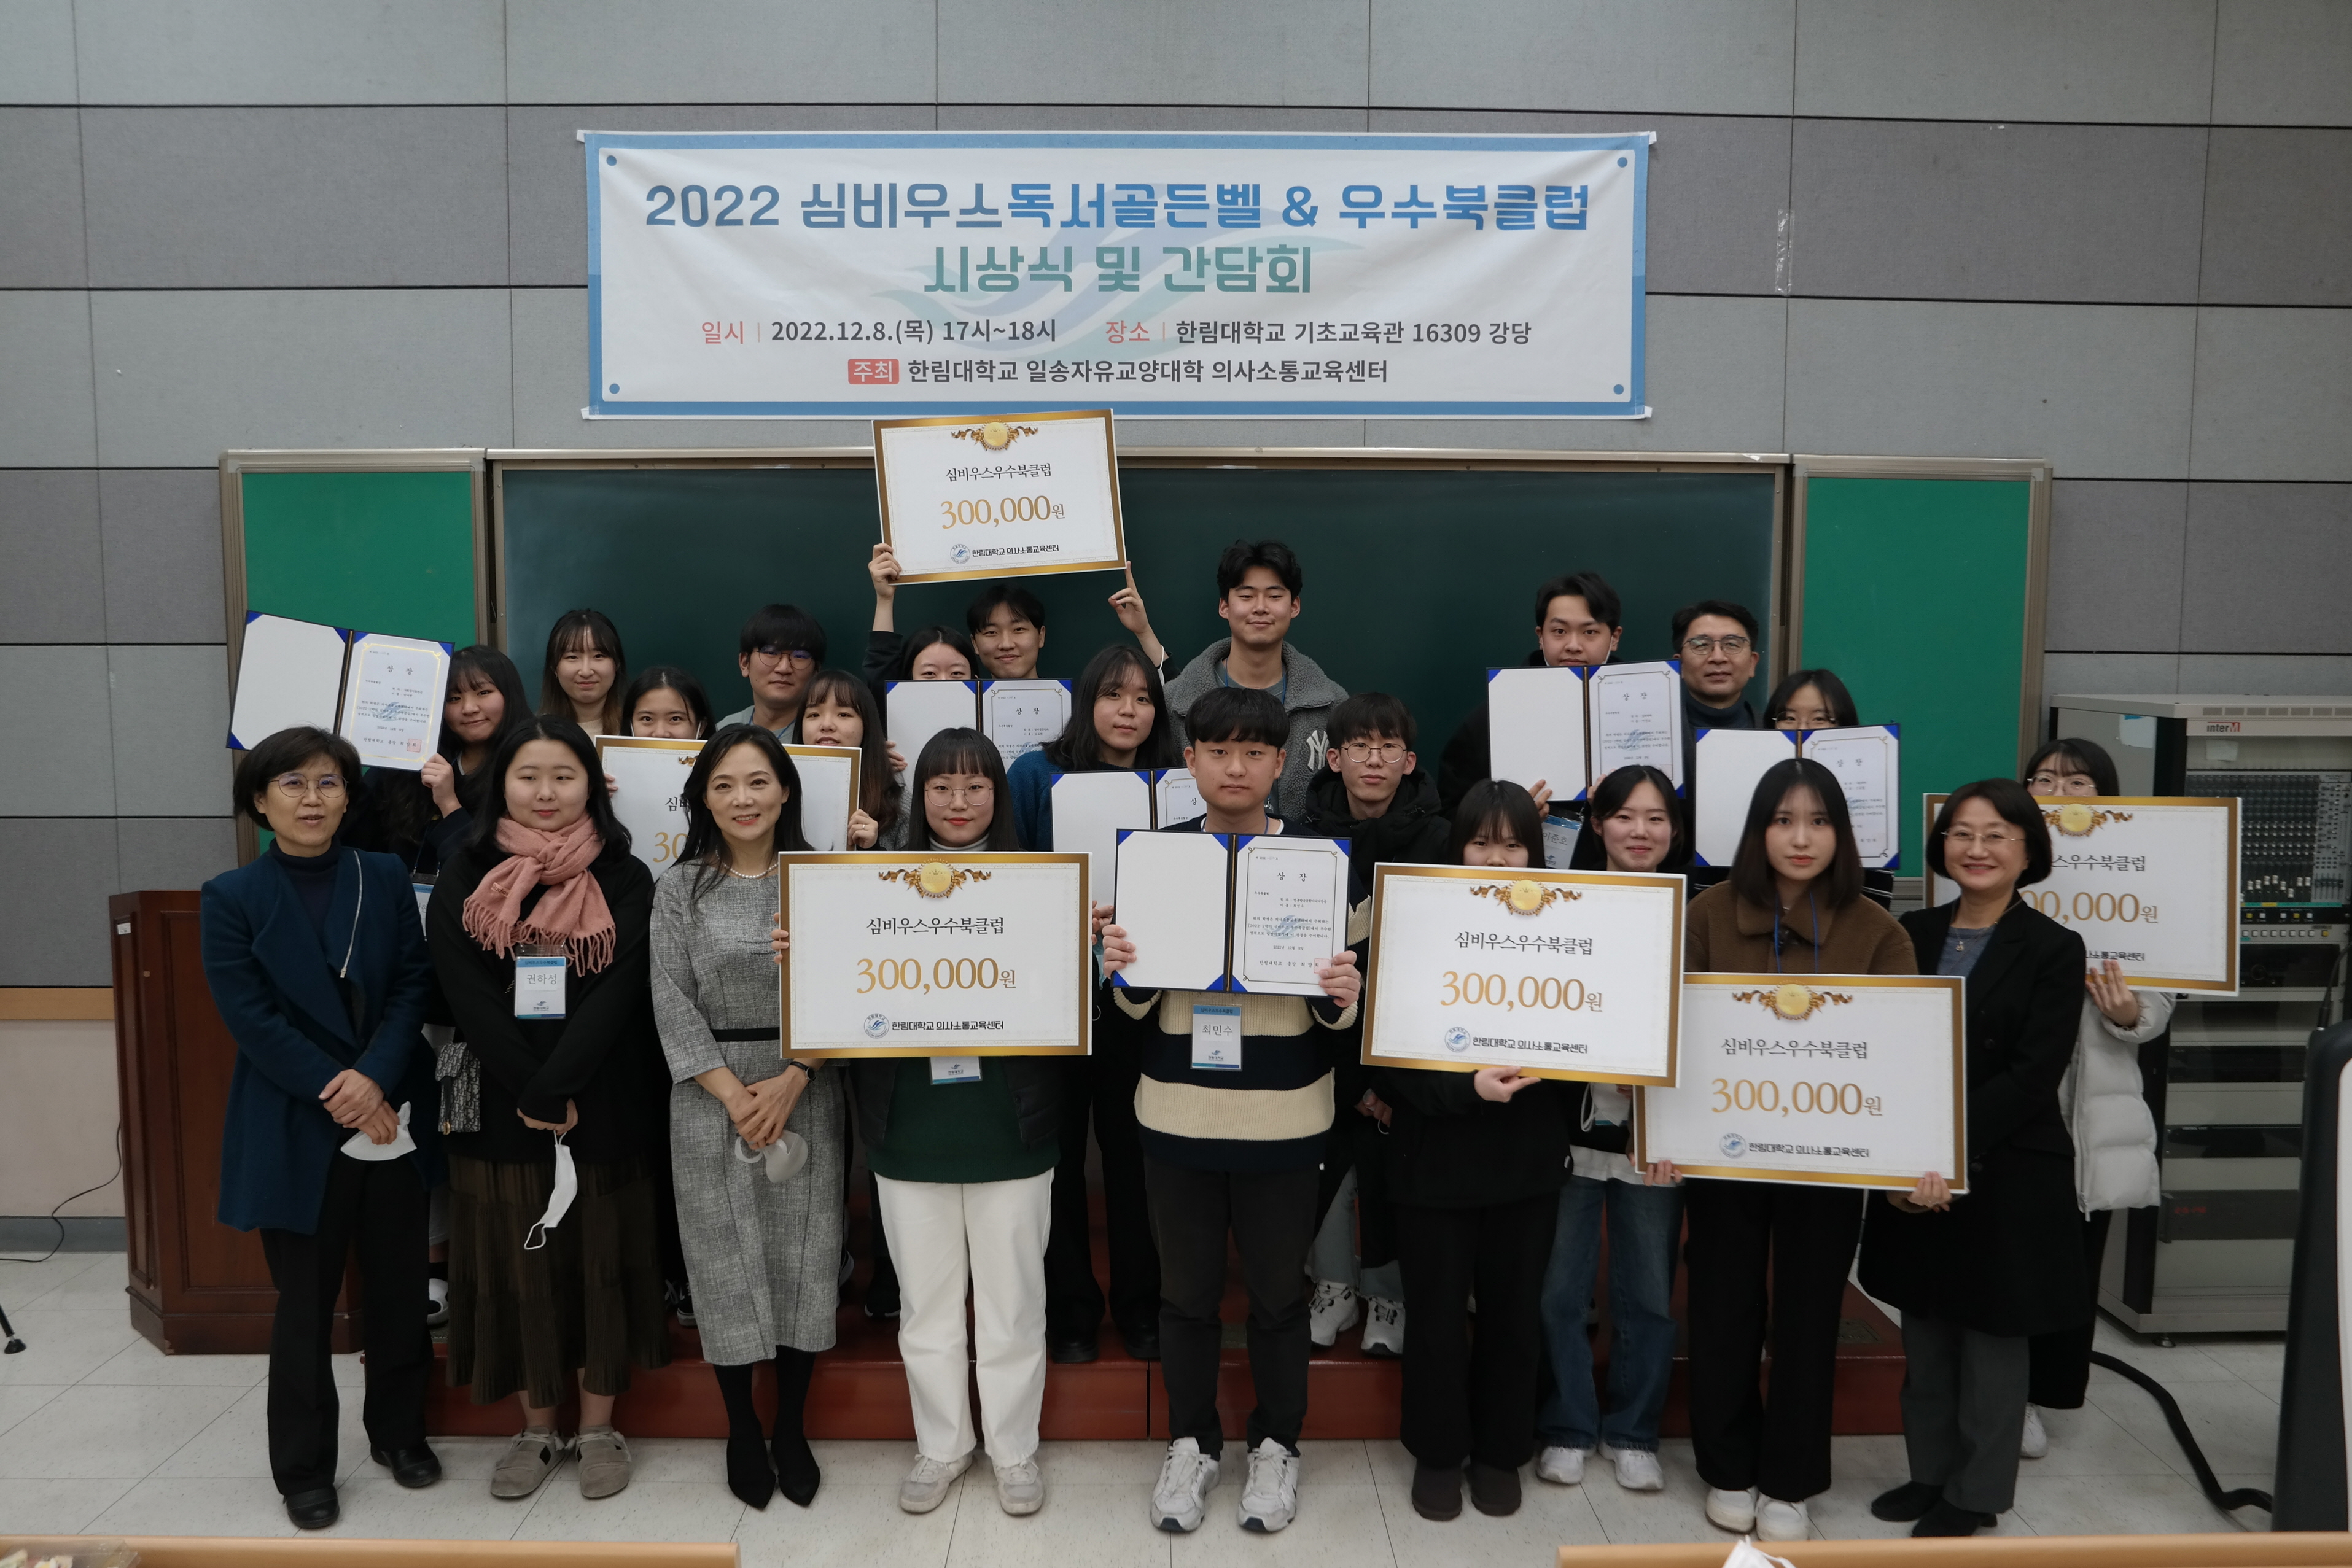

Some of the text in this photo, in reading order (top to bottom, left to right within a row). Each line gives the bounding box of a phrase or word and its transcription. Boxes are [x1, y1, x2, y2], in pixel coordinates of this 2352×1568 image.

[647, 183, 1587, 230] 2022 심비우스독서골든벨 & 우수북클럽
[925, 244, 1310, 293] 시상식 및 간담회
[702, 319, 1055, 344] 일시 2022.12.8.(목) 17시~18시
[1106, 320, 1531, 344] 장소 한림대학교 기초교육관 16309 강당
[854, 360, 1386, 382] 주최 한림대학교 일송자유교양대학 의사소통교육센터
[946, 463, 1051, 481] 심비우스우수북클럽
[941, 496, 1065, 529] 300,000원
[972, 545, 1059, 557] 한림대학교 의사소통교육센터
[1543, 831, 1568, 845] 이준호
[2052, 855, 2146, 872] 스우수북클럽
[1277, 872, 1307, 882] 상 장
[867, 917, 1003, 934] 심비우스우수북클럽
[1455, 932, 1592, 955] 심비우스우수북클럽
[527, 974, 557, 985] 권하성
[857, 958, 1016, 995] 300,000원
[1441, 971, 1602, 1012] 300,000원
[892, 1021, 1003, 1030] 한림대학교 의사소통교육센터
[1202, 1025, 1232, 1036] 최민수
[1473, 1037, 1515, 1048] 한림대학교
[1518, 1041, 1587, 1053] 의사소통교육센터
[1722, 1038, 1866, 1058] 심비우스우수북클럽
[1713, 1079, 1882, 1116] 300,000원
[1750, 1143, 1793, 1153] 한림대학교
[1796, 1146, 1868, 1157] 의사소통교육센터
